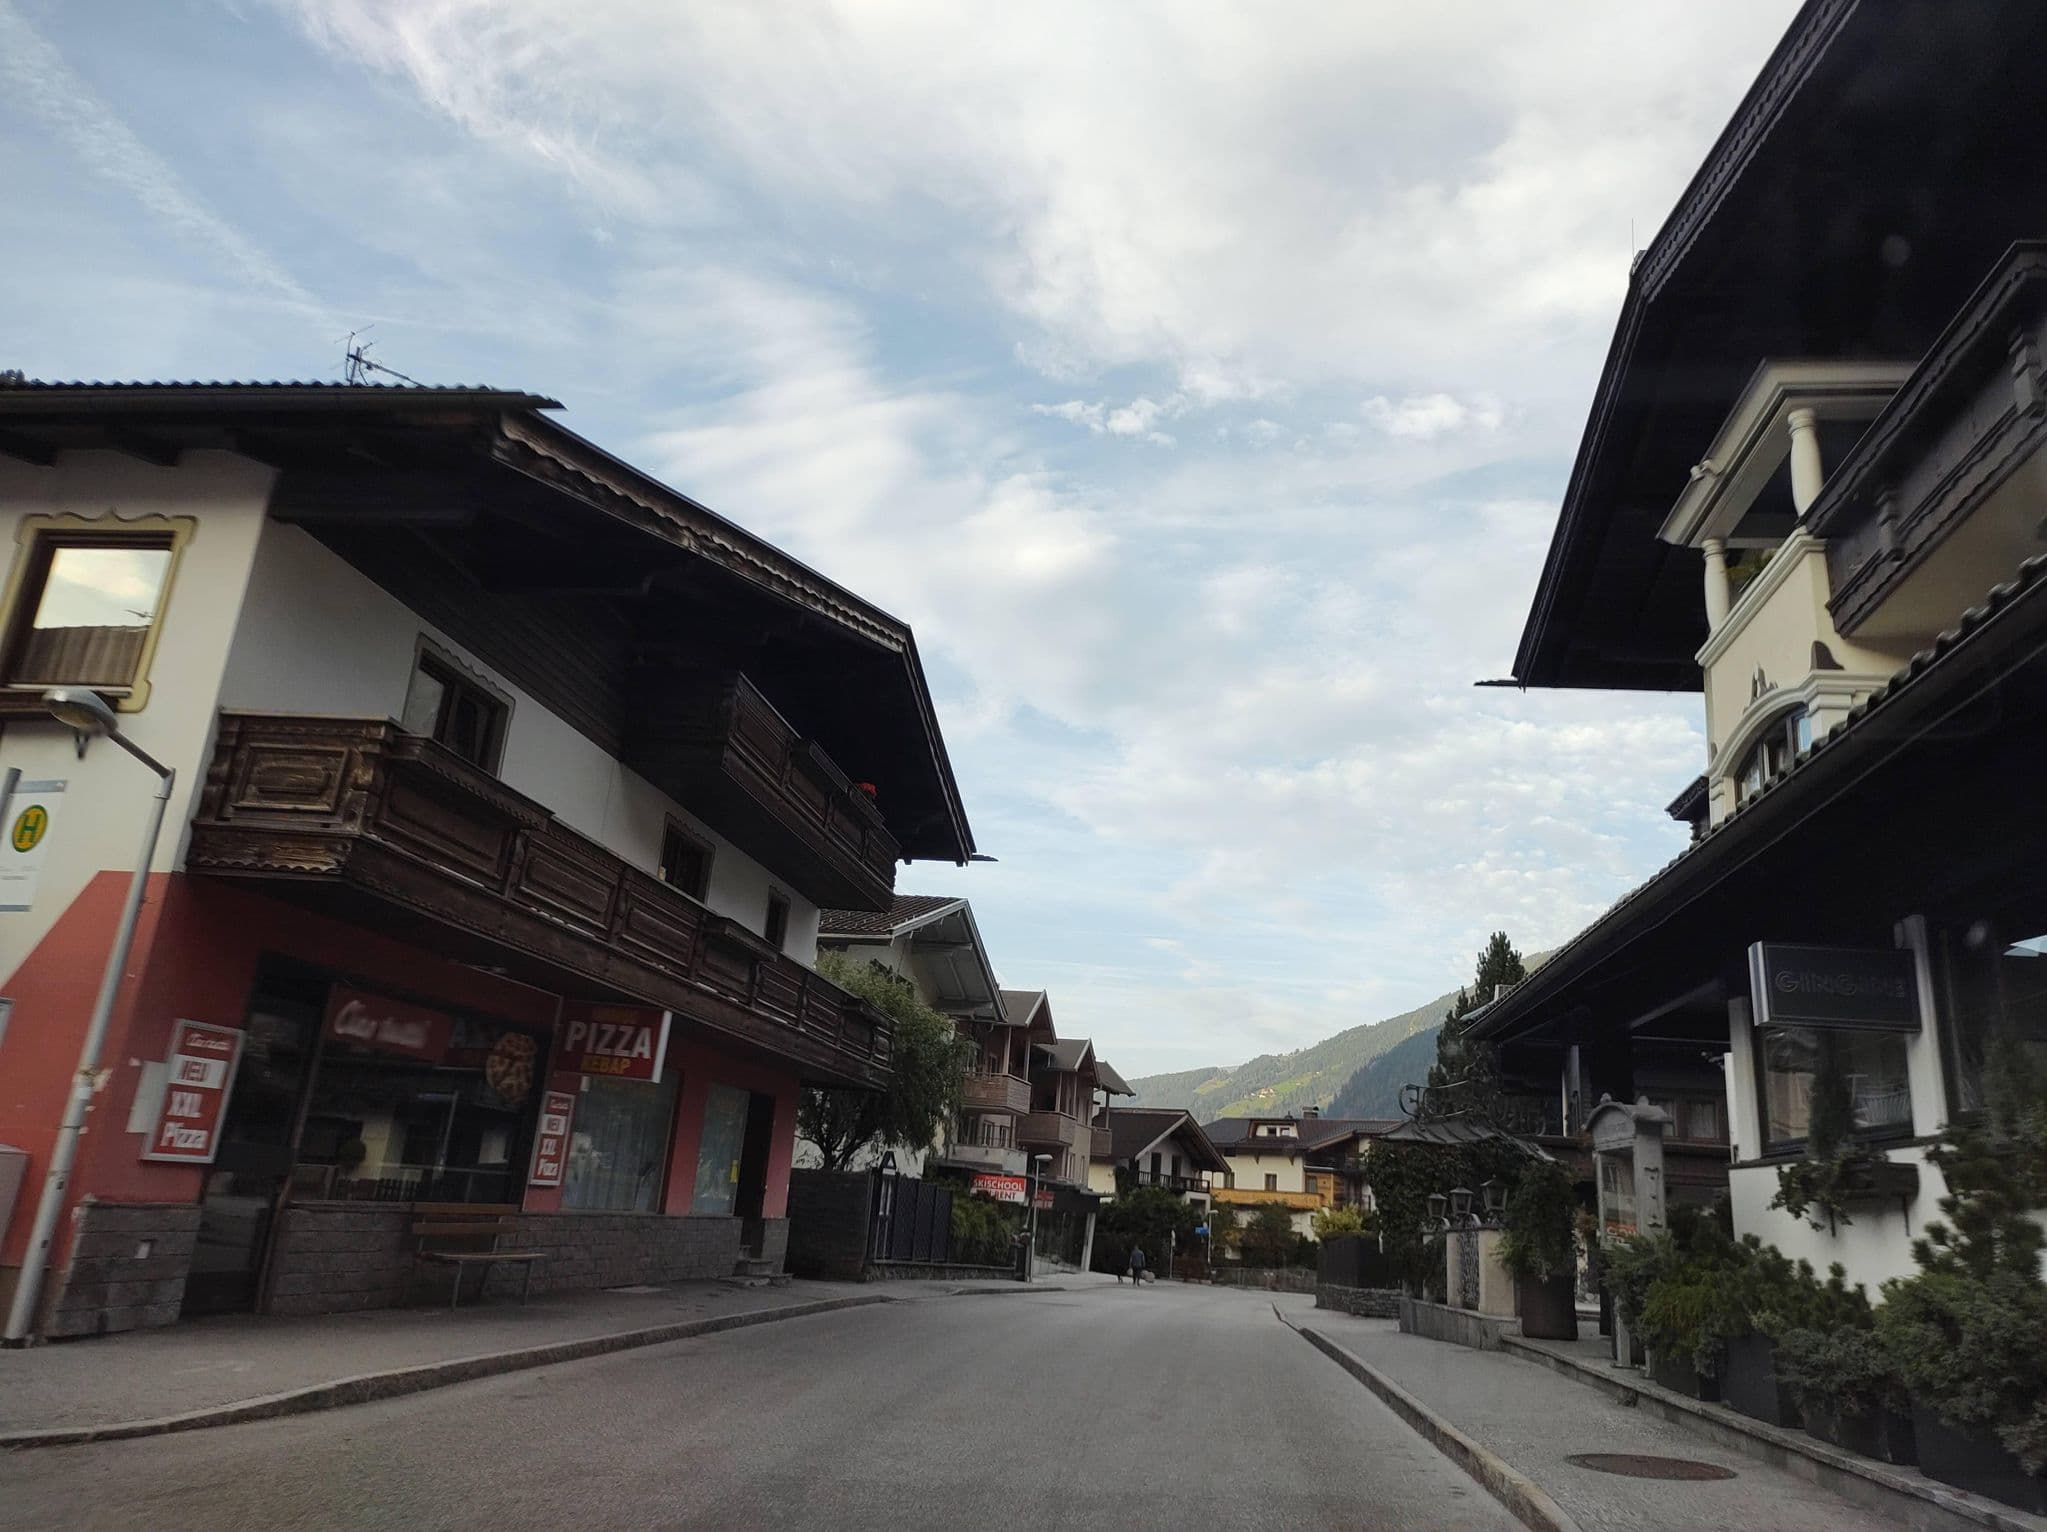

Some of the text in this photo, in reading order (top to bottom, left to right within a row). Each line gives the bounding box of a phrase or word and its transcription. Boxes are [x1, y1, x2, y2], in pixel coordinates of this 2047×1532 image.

[17, 813, 41, 843] H
[565, 1020, 652, 1060] PIZZA
[581, 1054, 632, 1075] KEBAP
[160, 1120, 209, 1150] Pizza
[973, 1177, 1023, 1192] SKISCHOOL
